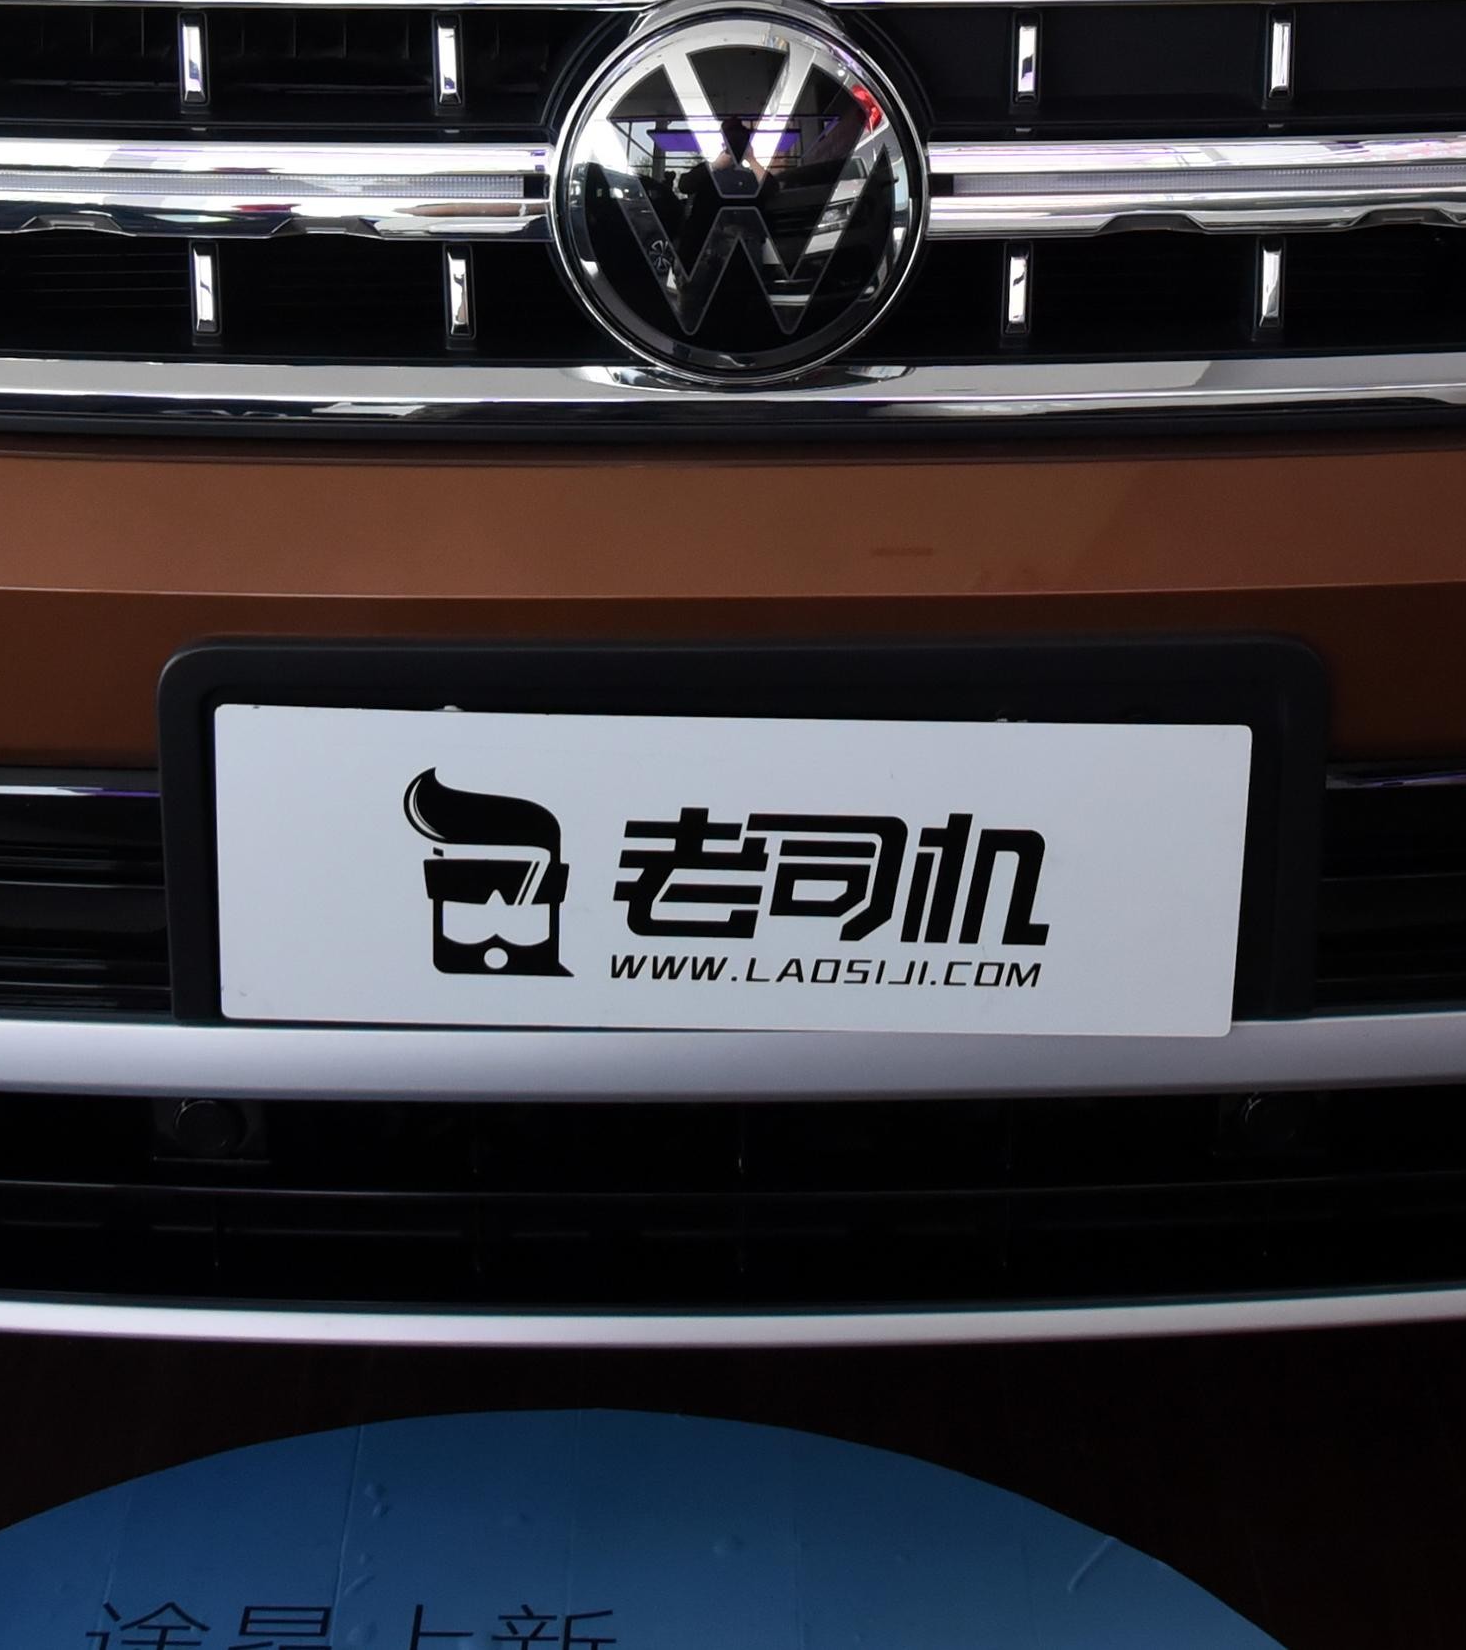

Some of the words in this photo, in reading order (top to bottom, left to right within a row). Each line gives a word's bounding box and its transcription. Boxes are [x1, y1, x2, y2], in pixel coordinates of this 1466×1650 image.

[613, 807, 1050, 946] 老司机
[611, 954, 1043, 990] WWW.LAOSIJI.COM
